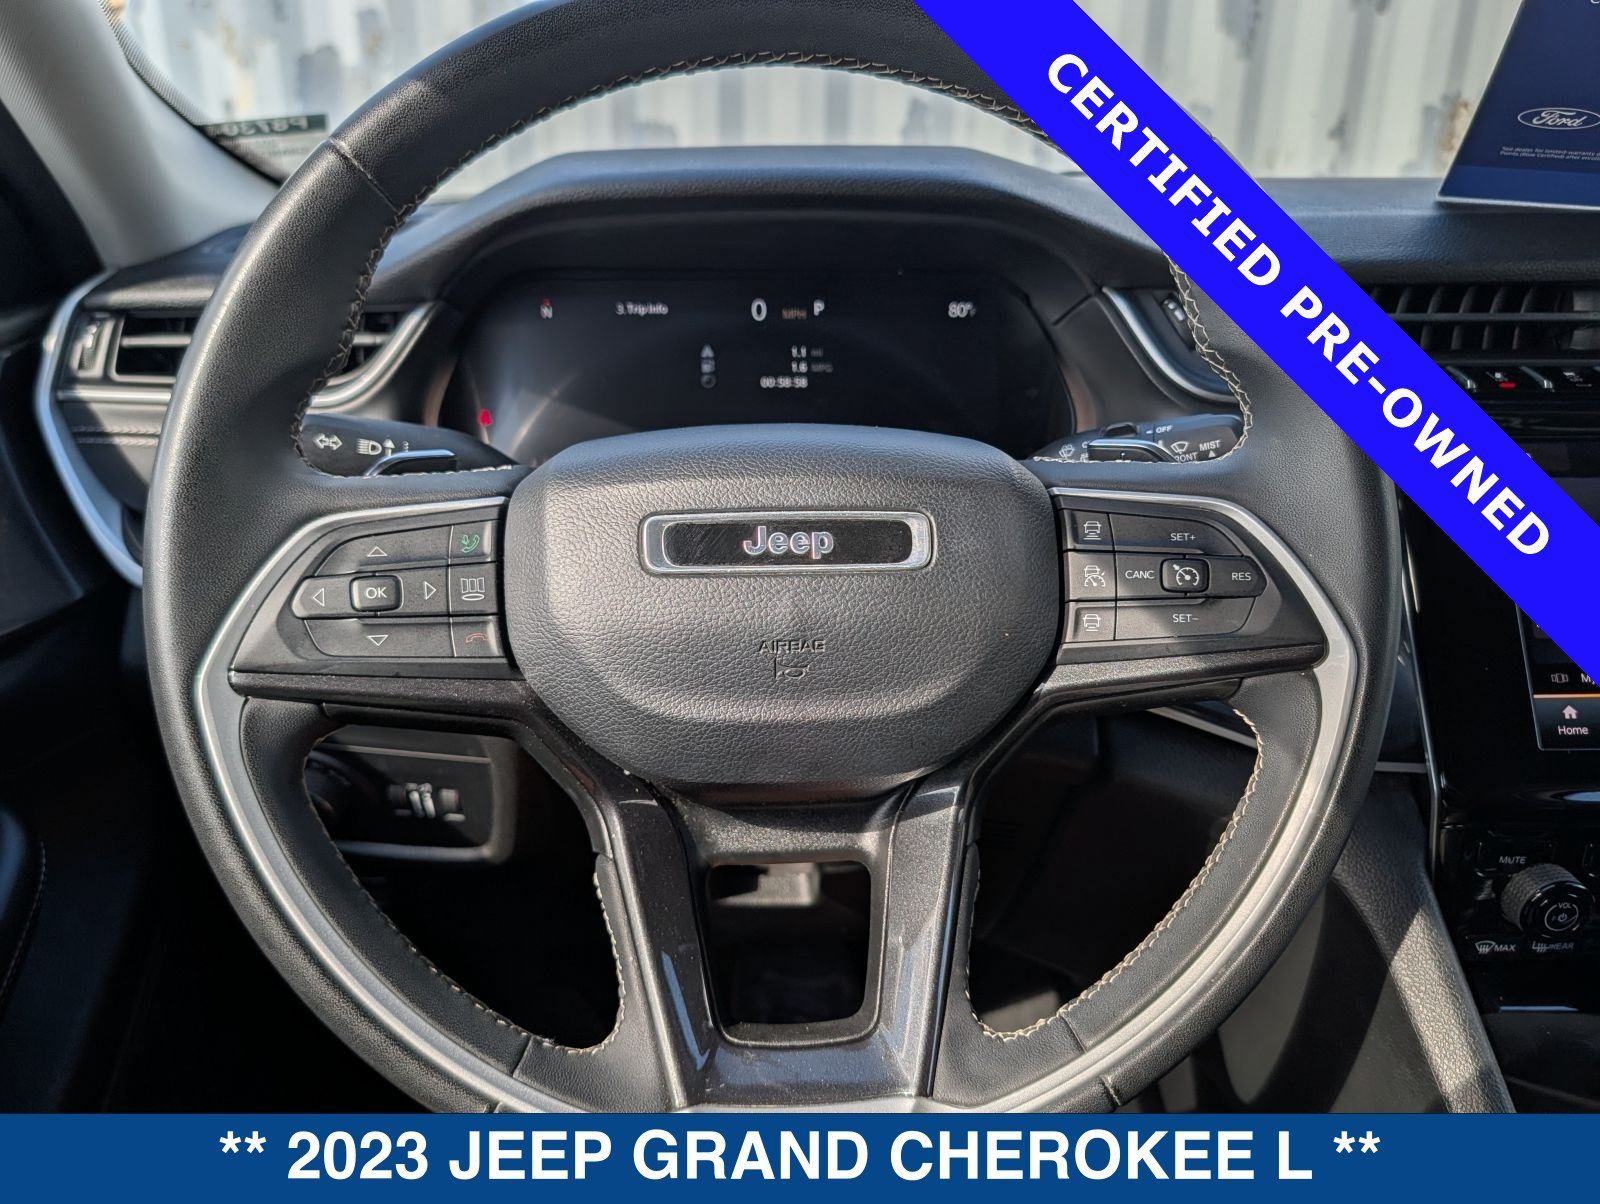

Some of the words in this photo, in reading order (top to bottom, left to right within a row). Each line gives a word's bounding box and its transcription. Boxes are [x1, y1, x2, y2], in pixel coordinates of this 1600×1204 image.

[1532, 110, 1588, 127] Ford
[813, 299, 825, 317] P
[1156, 425, 1173, 434] OFF
[1199, 440, 1221, 451] MIST
[743, 526, 834, 559] Jeep
[1125, 570, 1155, 580] CANC
[1231, 573, 1252, 581] RES
[365, 587, 388, 599] OK
[758, 640, 827, 655] AIRBAG
[1557, 725, 1589, 736] Home
[1498, 855, 1528, 865] MUTE
[1493, 944, 1517, 952] MAX
